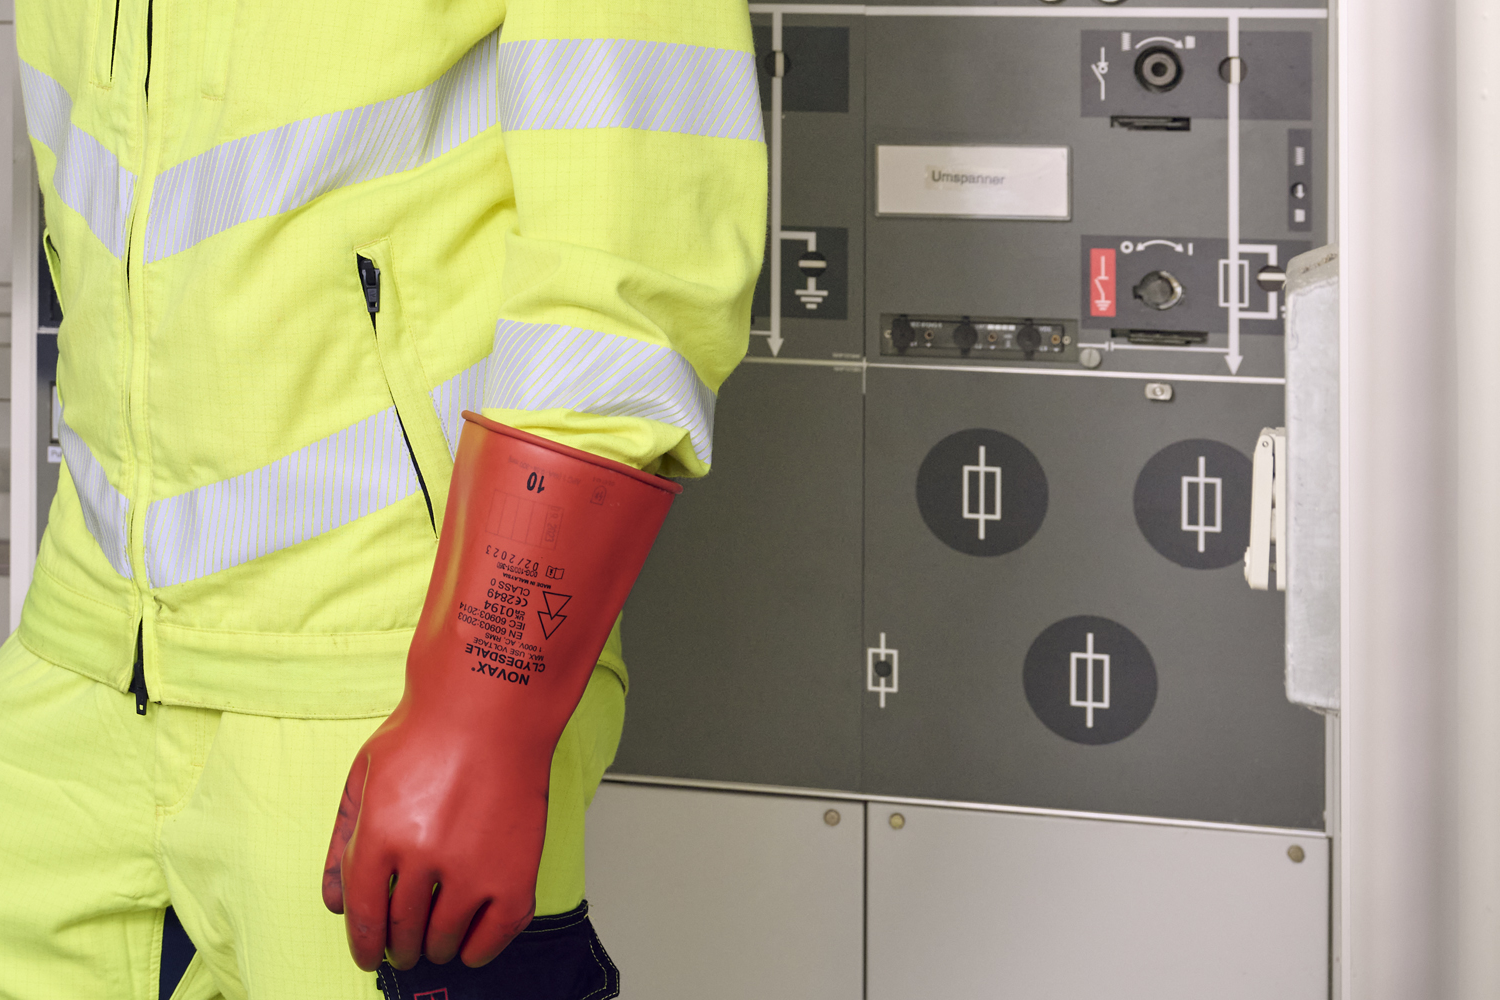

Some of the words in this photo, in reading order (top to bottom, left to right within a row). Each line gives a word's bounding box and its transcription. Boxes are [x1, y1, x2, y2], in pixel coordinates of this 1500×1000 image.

[931, 170, 1005, 186] Umspanner
[527, 472, 545, 494] 10
[490, 578, 497, 587] 0
[502, 572, 529, 584] MALAYSIA
[498, 581, 530, 597] CLASS
[459, 601, 507, 626] 60903:2014
[484, 600, 514, 618] 0194
[457, 611, 507, 635] 60903:2003
[508, 619, 526, 631] IEC
[485, 632, 502, 642] RMS
[509, 629, 523, 640] EN
[473, 637, 508, 653] VOLTAGE
[510, 648, 525, 658] USE
[465, 643, 546, 673] CLYDESDALE
